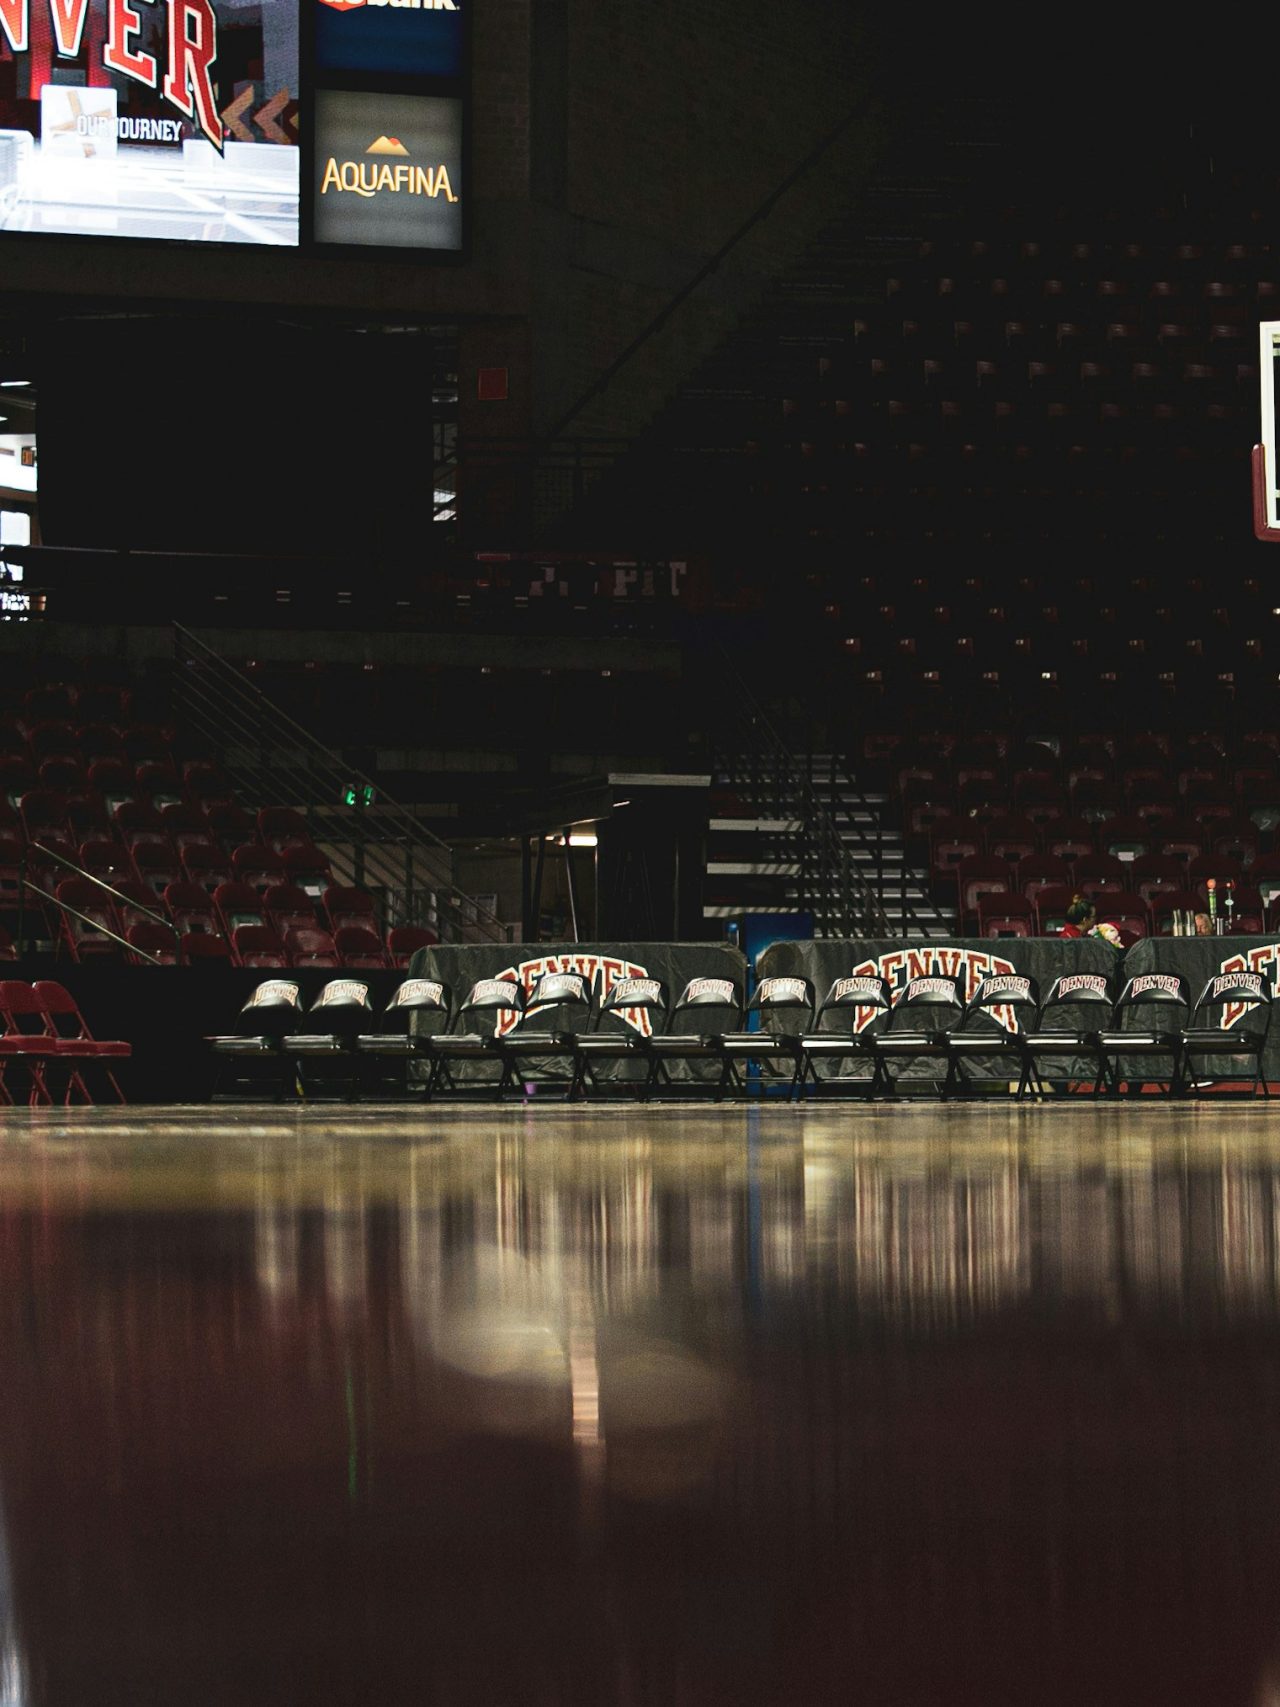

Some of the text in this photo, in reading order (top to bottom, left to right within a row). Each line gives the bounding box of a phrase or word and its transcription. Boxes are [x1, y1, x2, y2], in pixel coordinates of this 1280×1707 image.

[320, 157, 454, 203] AQUAFINA
[687, 979, 734, 1003] DENVER
[835, 978, 882, 1002] DENVER
[908, 978, 955, 1003] DENVER
[983, 976, 1030, 999] DENVER
[1058, 975, 1107, 998] DENVER
[1131, 975, 1180, 998] DENVER
[1213, 973, 1262, 998] DENVER
